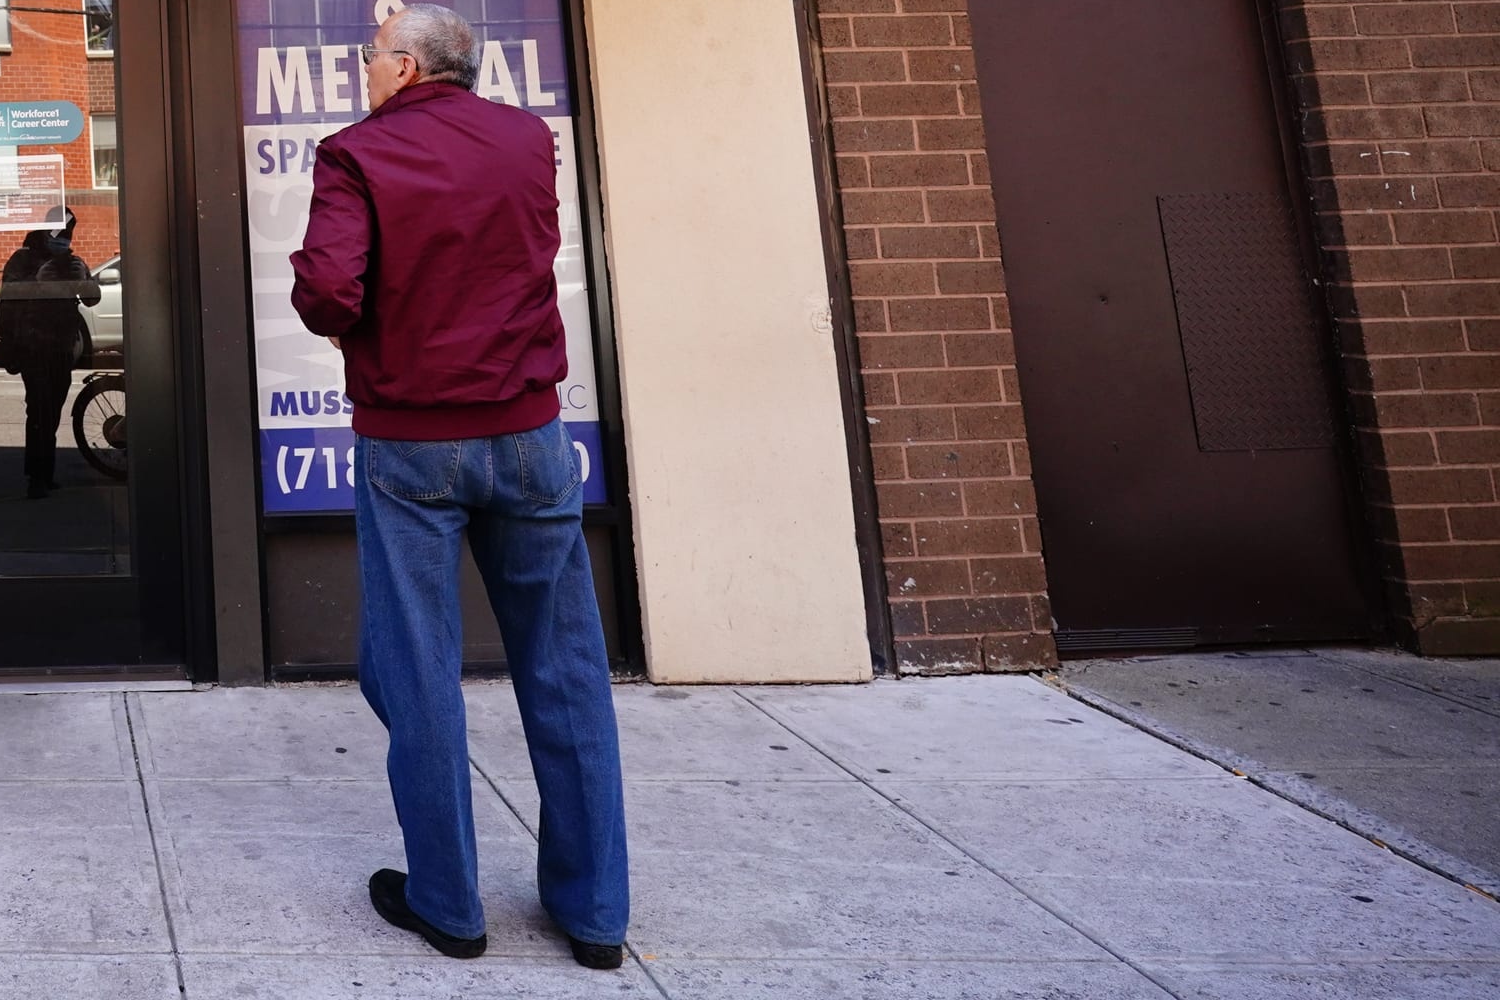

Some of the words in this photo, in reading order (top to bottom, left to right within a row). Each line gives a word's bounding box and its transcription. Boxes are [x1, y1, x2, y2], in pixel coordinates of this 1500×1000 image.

[256, 39, 556, 115] MEAL
[11, 109, 59, 118] Workforce1
[11, 120, 39, 128] Career
[41, 119, 70, 127] Center
[270, 390, 354, 417] MUSS
